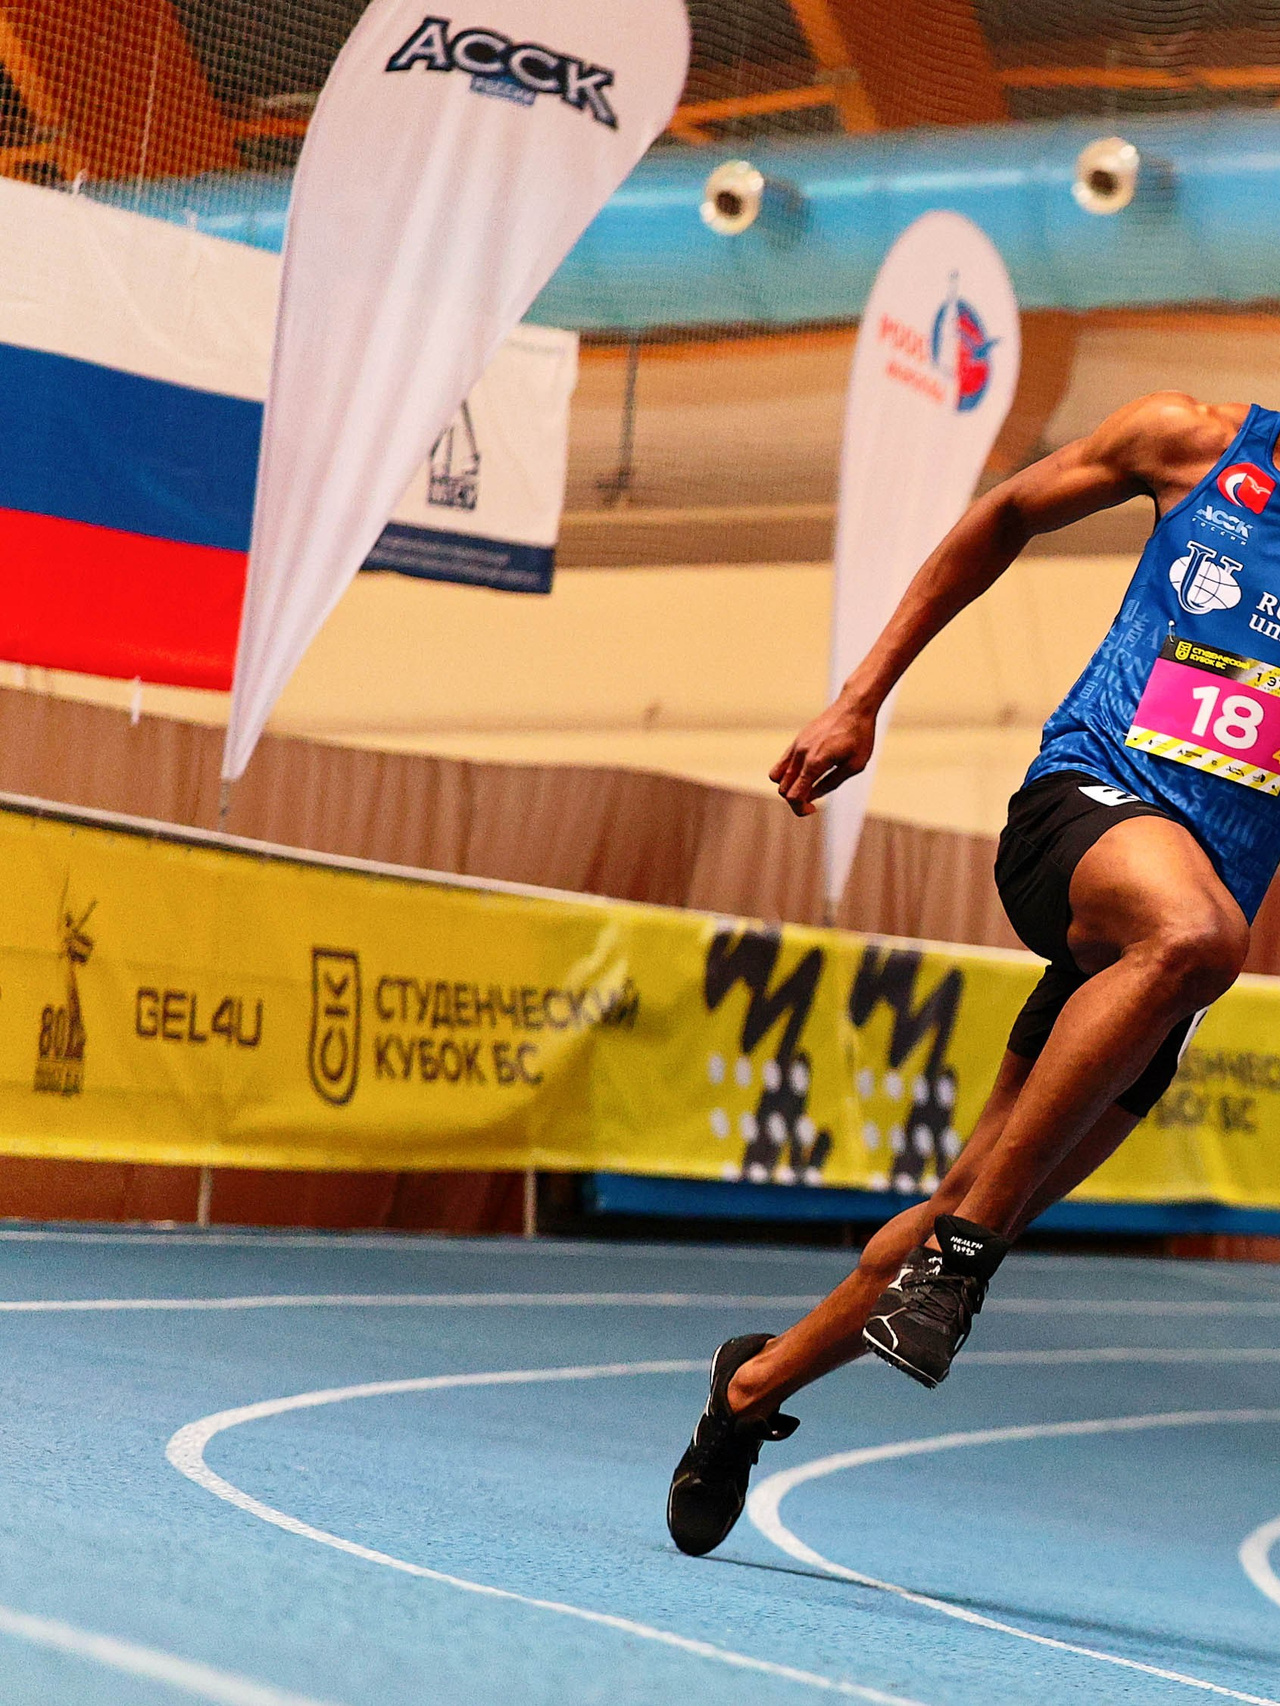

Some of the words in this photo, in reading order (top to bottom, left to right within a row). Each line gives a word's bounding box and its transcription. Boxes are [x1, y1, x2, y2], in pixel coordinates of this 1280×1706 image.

[385, 15, 618, 130] АССК
[1257, 672, 1263, 682] 1
[1191, 685, 1264, 750] 18
[136, 987, 263, 1048] GEL4U
[373, 974, 639, 1031] СТУДЕНЧЕСКИЙ
[373, 1034, 488, 1085] КУБОК
[493, 1041, 543, 1086] БС
